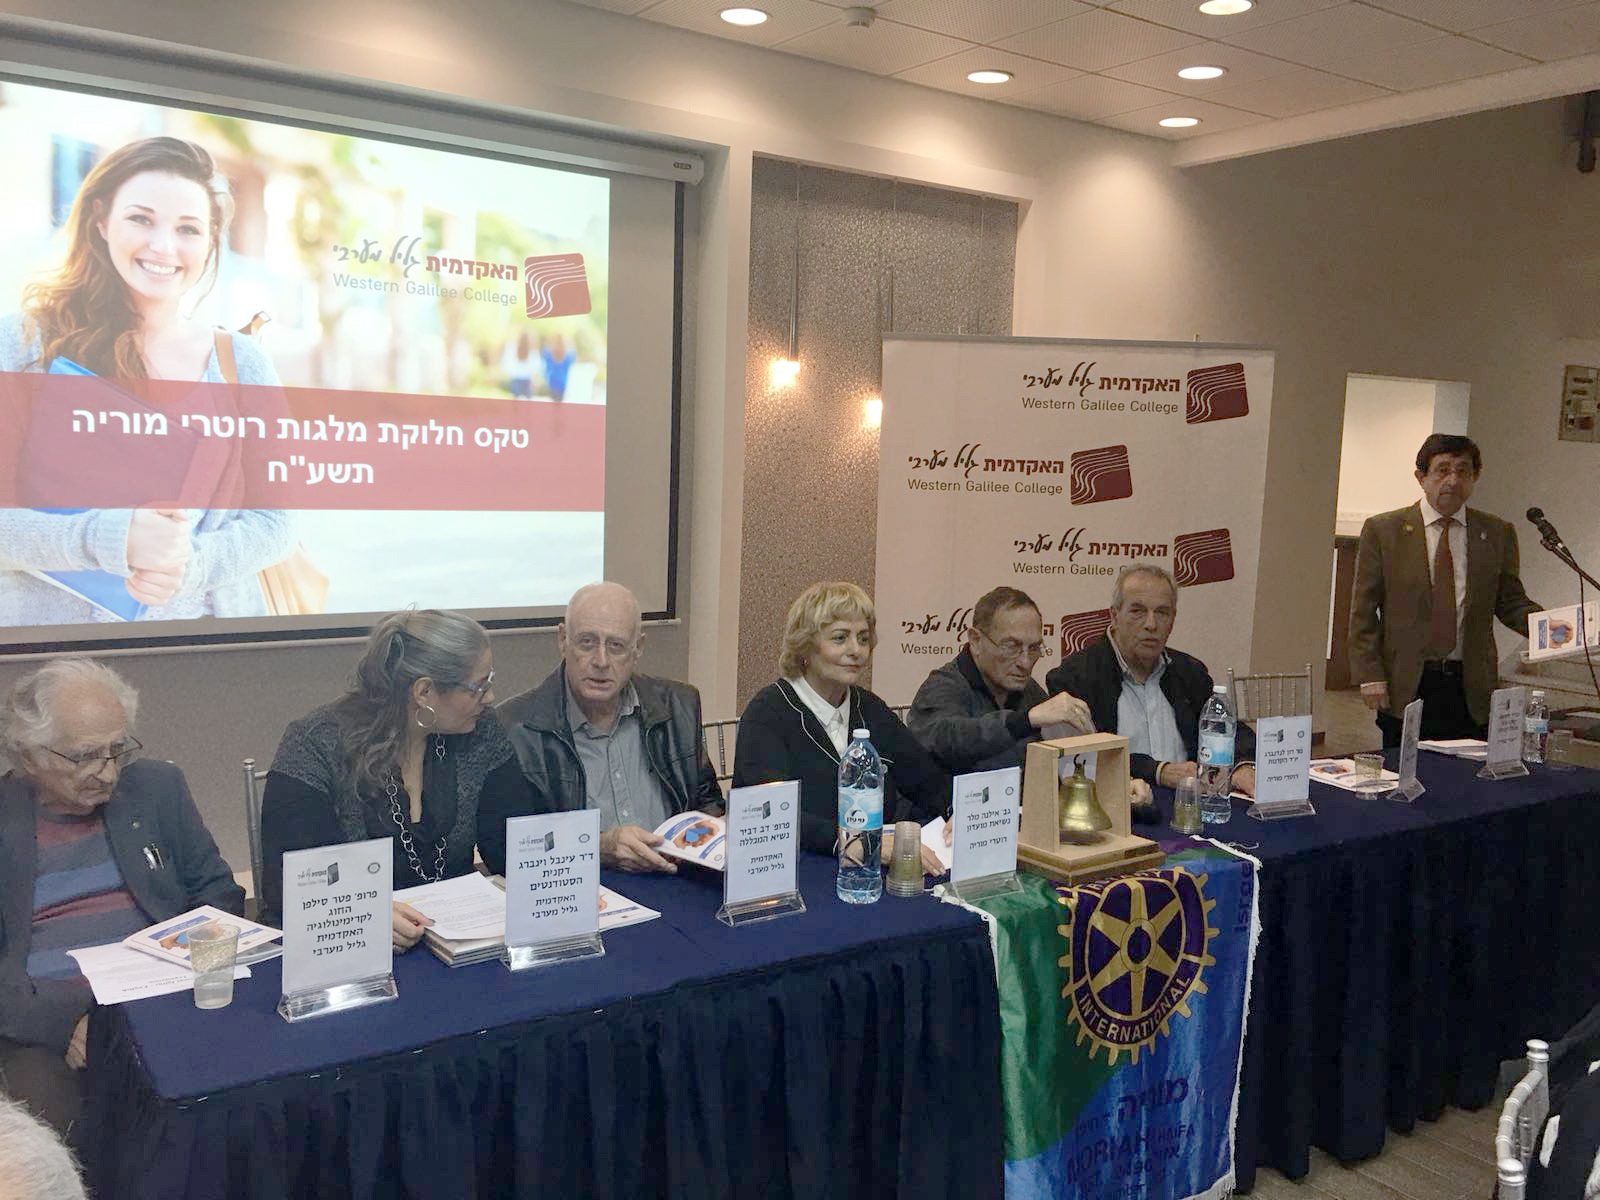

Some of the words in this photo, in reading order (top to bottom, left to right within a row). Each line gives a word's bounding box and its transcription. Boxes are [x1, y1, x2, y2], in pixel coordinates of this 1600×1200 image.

[426, 255, 518, 281] האקדמית
[333, 273, 399, 293] Western
[406, 280, 457, 299] Galilee
[463, 286, 518, 306] College
[1098, 375, 1181, 393] האקדמית
[1021, 397, 1075, 411] Western
[1080, 398, 1126, 412] Galilee
[1130, 400, 1179, 415] College
[72, 407, 168, 436] מוריה
[181, 414, 266, 439] רוטרי
[276, 414, 367, 442] מלגות
[378, 419, 464, 451] חלוקת
[473, 426, 529, 453] טקס
[267, 456, 374, 485] תשע"ח
[983, 456, 1065, 475] האקדמית
[907, 478, 961, 492] Western
[965, 480, 1010, 494] Galilee
[1014, 481, 1063, 496] College
[1088, 541, 1168, 558] האקדמית
[1013, 562, 1065, 575] Western
[1070, 563, 1114, 576] Galilee
[901, 642, 953, 656] Western
[740, 827, 757, 836] דביר
[760, 825, 770, 833] דב
[739, 835, 768, 847] המכללה
[770, 832, 790, 841] נשיא
[518, 858, 547, 870] וינברג
[550, 854, 576, 865] עינבל
[750, 852, 783, 864] האקדמית
[542, 866, 571, 878] דקנית
[747, 865, 769, 875] מערבי
[771, 862, 785, 872] גליל
[530, 876, 583, 891] הסטודנטים
[302, 897, 329, 911] סילפן
[332, 893, 352, 904] פטר
[535, 894, 576, 907] האקדמית
[328, 905, 352, 916] החוג
[532, 908, 558, 919] מערבי
[561, 904, 578, 914] גליל
[306, 912, 372, 932] לקרימינולוגיה
[316, 927, 364, 943] האקדמית
[312, 945, 344, 957] מערבי
[346, 938, 366, 951] גליל
[1079, 978, 1191, 1042] INTERNATIONAL
